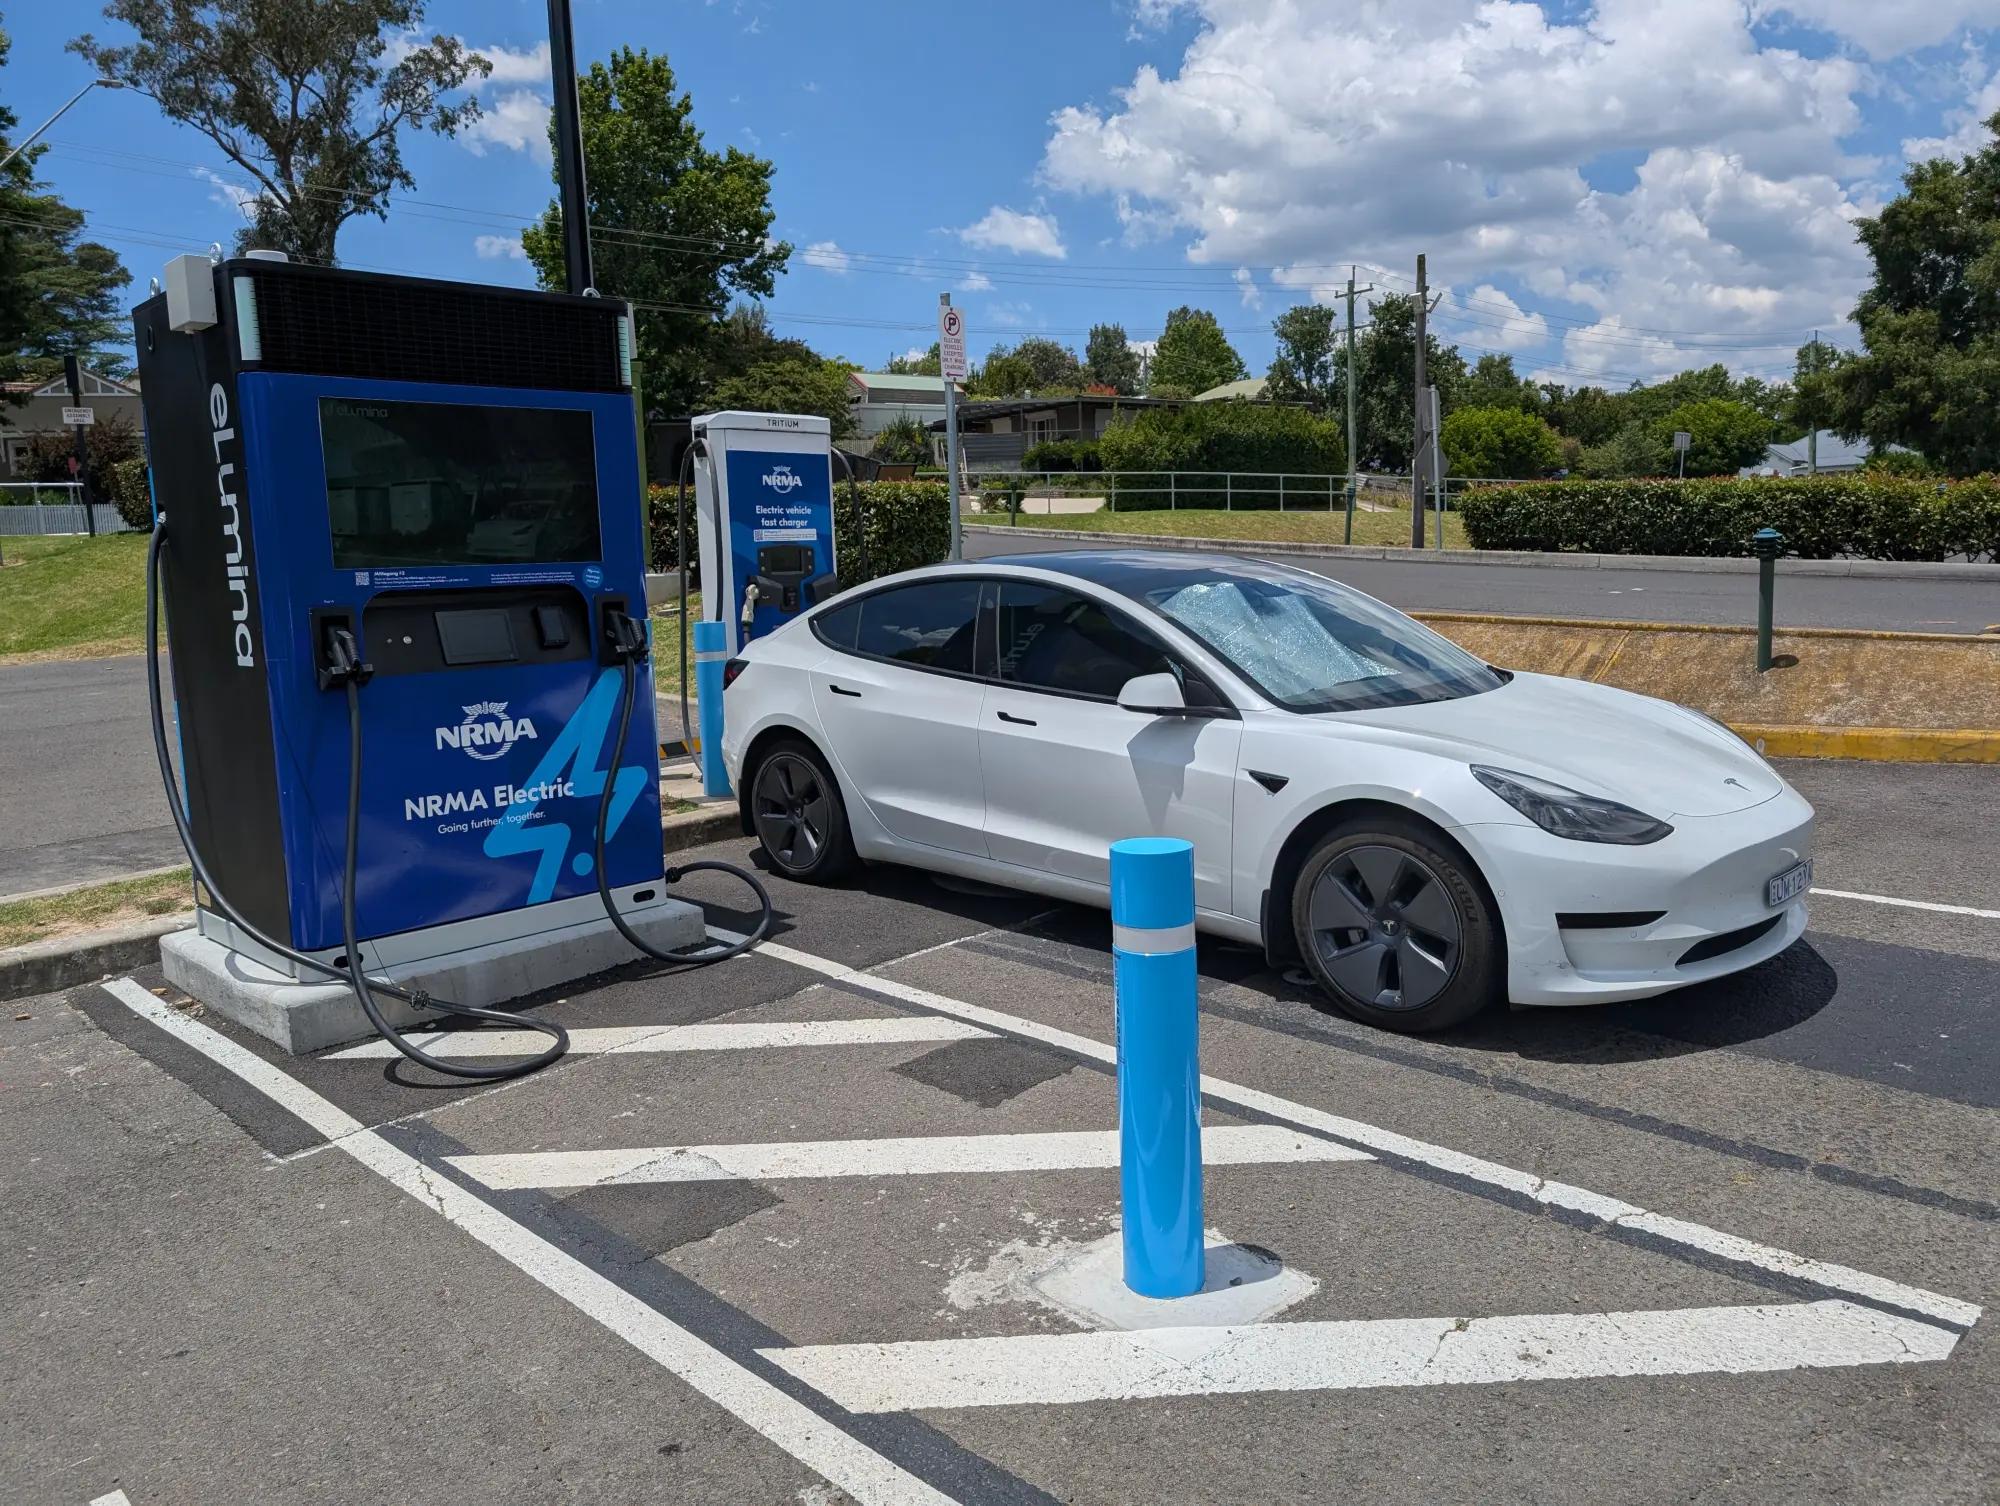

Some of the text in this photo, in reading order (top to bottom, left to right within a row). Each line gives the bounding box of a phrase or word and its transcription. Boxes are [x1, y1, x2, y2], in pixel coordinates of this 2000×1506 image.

[767, 418, 799, 428] TRITIUM
[762, 475, 802, 486] NRMA
[755, 505, 812, 514] Electric vehicle
[210, 382, 254, 667] eLumina
[761, 517, 808, 528] fast charger
[435, 717, 538, 750] NRMA
[405, 777, 575, 821] NRMA Electric
[438, 822, 469, 834] Going
[506, 810, 547, 824] together.
[1429, 851, 1479, 922] MICHELIN
